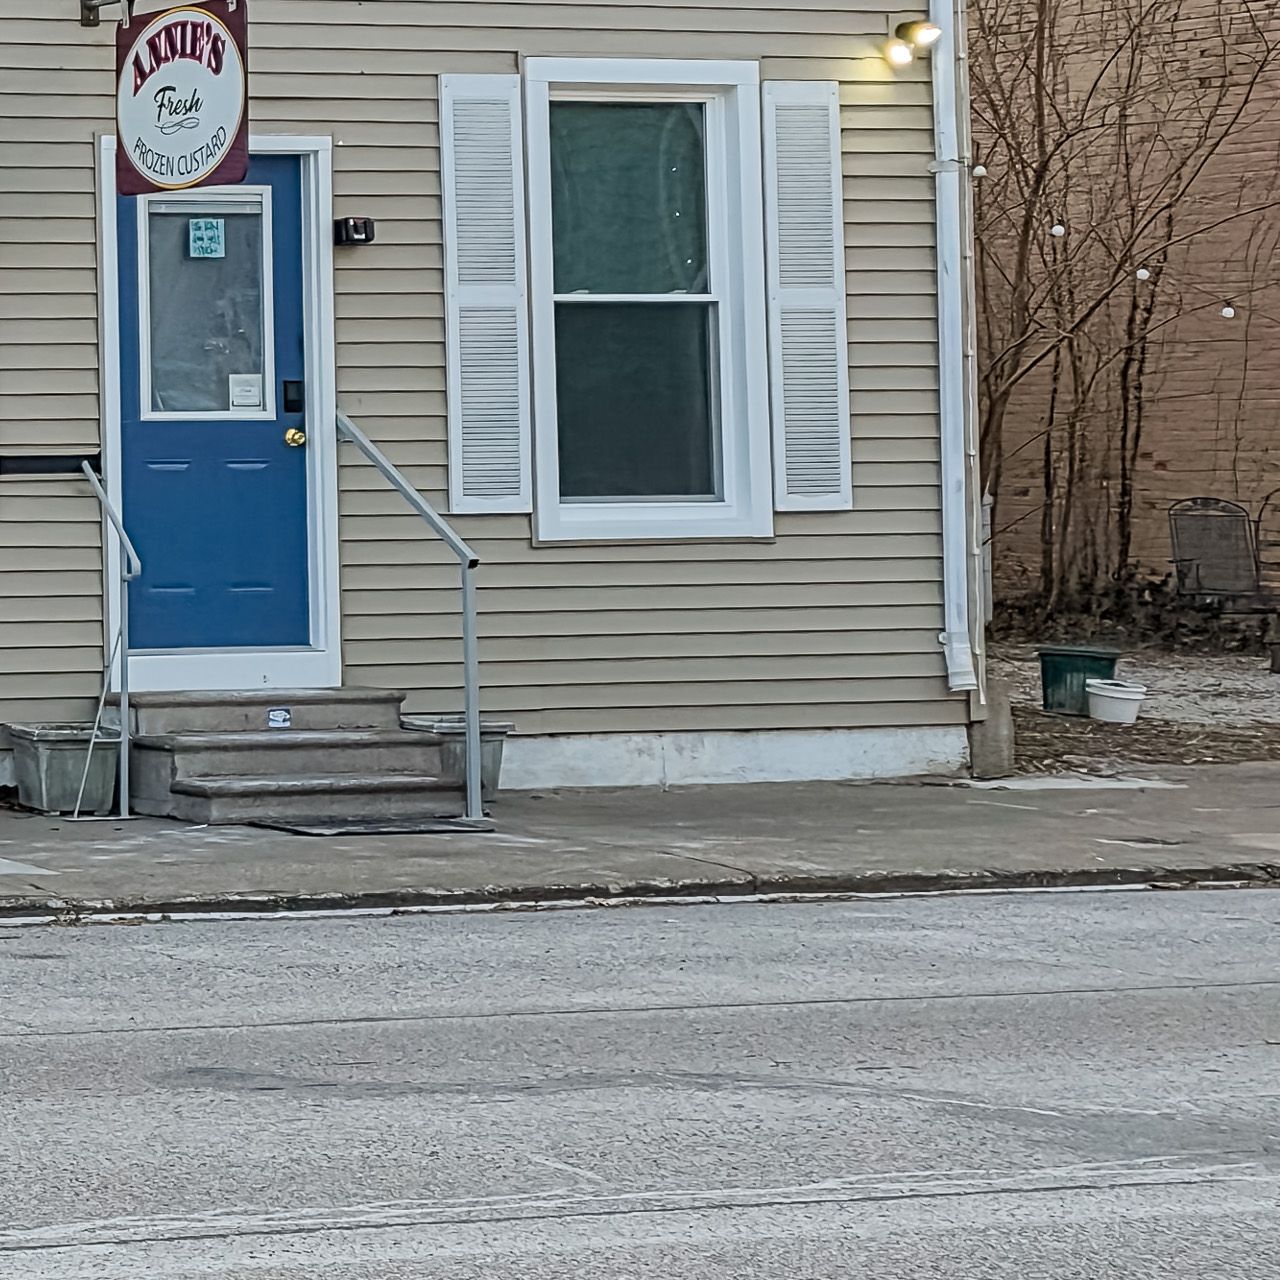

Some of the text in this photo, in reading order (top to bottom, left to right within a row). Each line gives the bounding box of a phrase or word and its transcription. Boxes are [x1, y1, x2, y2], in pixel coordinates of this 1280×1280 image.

[131, 20, 226, 97] ANNIE'S
[154, 86, 204, 122] Fresh
[134, 126, 227, 177] FROZEN CUSTARD
